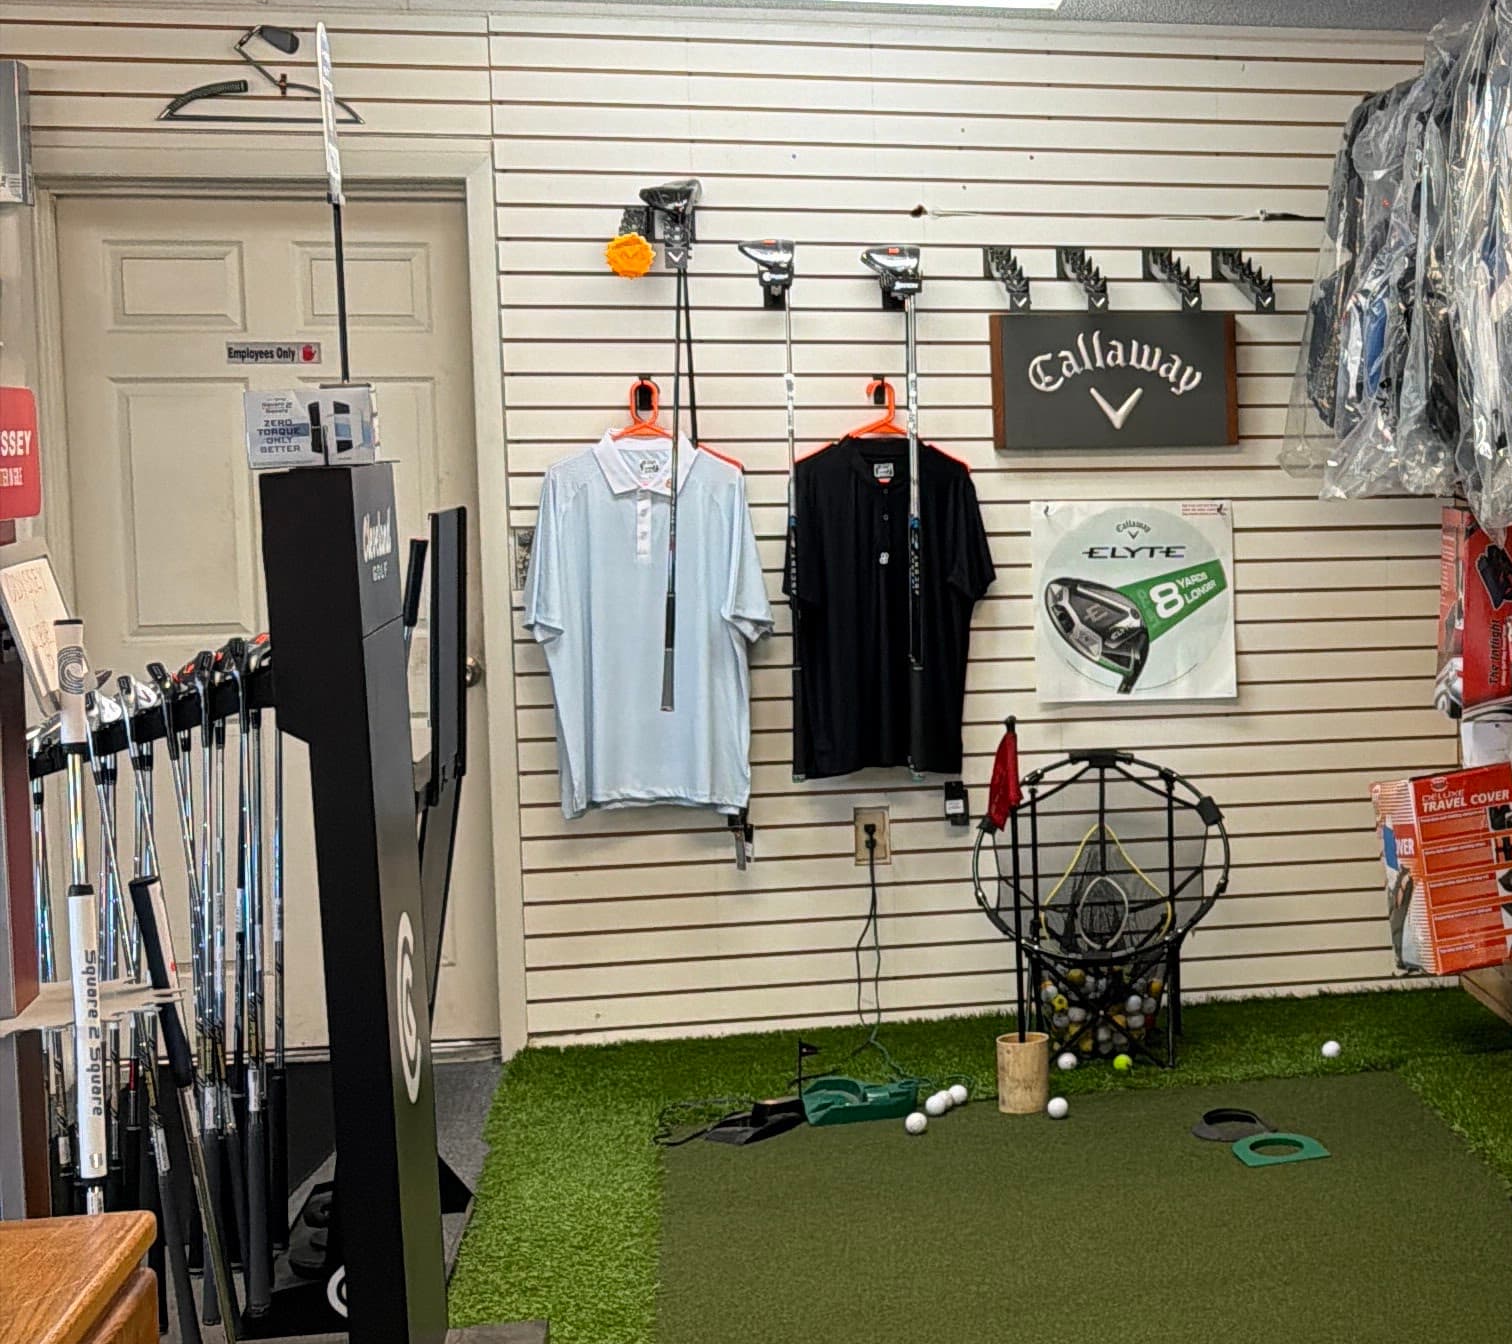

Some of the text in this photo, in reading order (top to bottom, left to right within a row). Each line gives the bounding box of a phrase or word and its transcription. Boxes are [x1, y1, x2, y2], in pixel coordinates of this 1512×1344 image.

[227, 343, 296, 361] Employees Only
[1028, 330, 1203, 396] Callaway
[256, 428, 300, 436] TORQUE
[263, 419, 293, 427] ZERO
[0, 430, 32, 456] SSEY
[259, 445, 301, 453] BETTER
[265, 436, 293, 444] ONLY
[1116, 519, 1151, 534] Callaway
[1081, 545, 1187, 559] ELYTE
[1175, 571, 1208, 589] YARDS
[1149, 581, 1185, 619] 8
[1183, 579, 1217, 605] LONGER
[1423, 788, 1510, 813] TRAVEL COVER
[81, 949, 103, 1117] Square 2 Square
